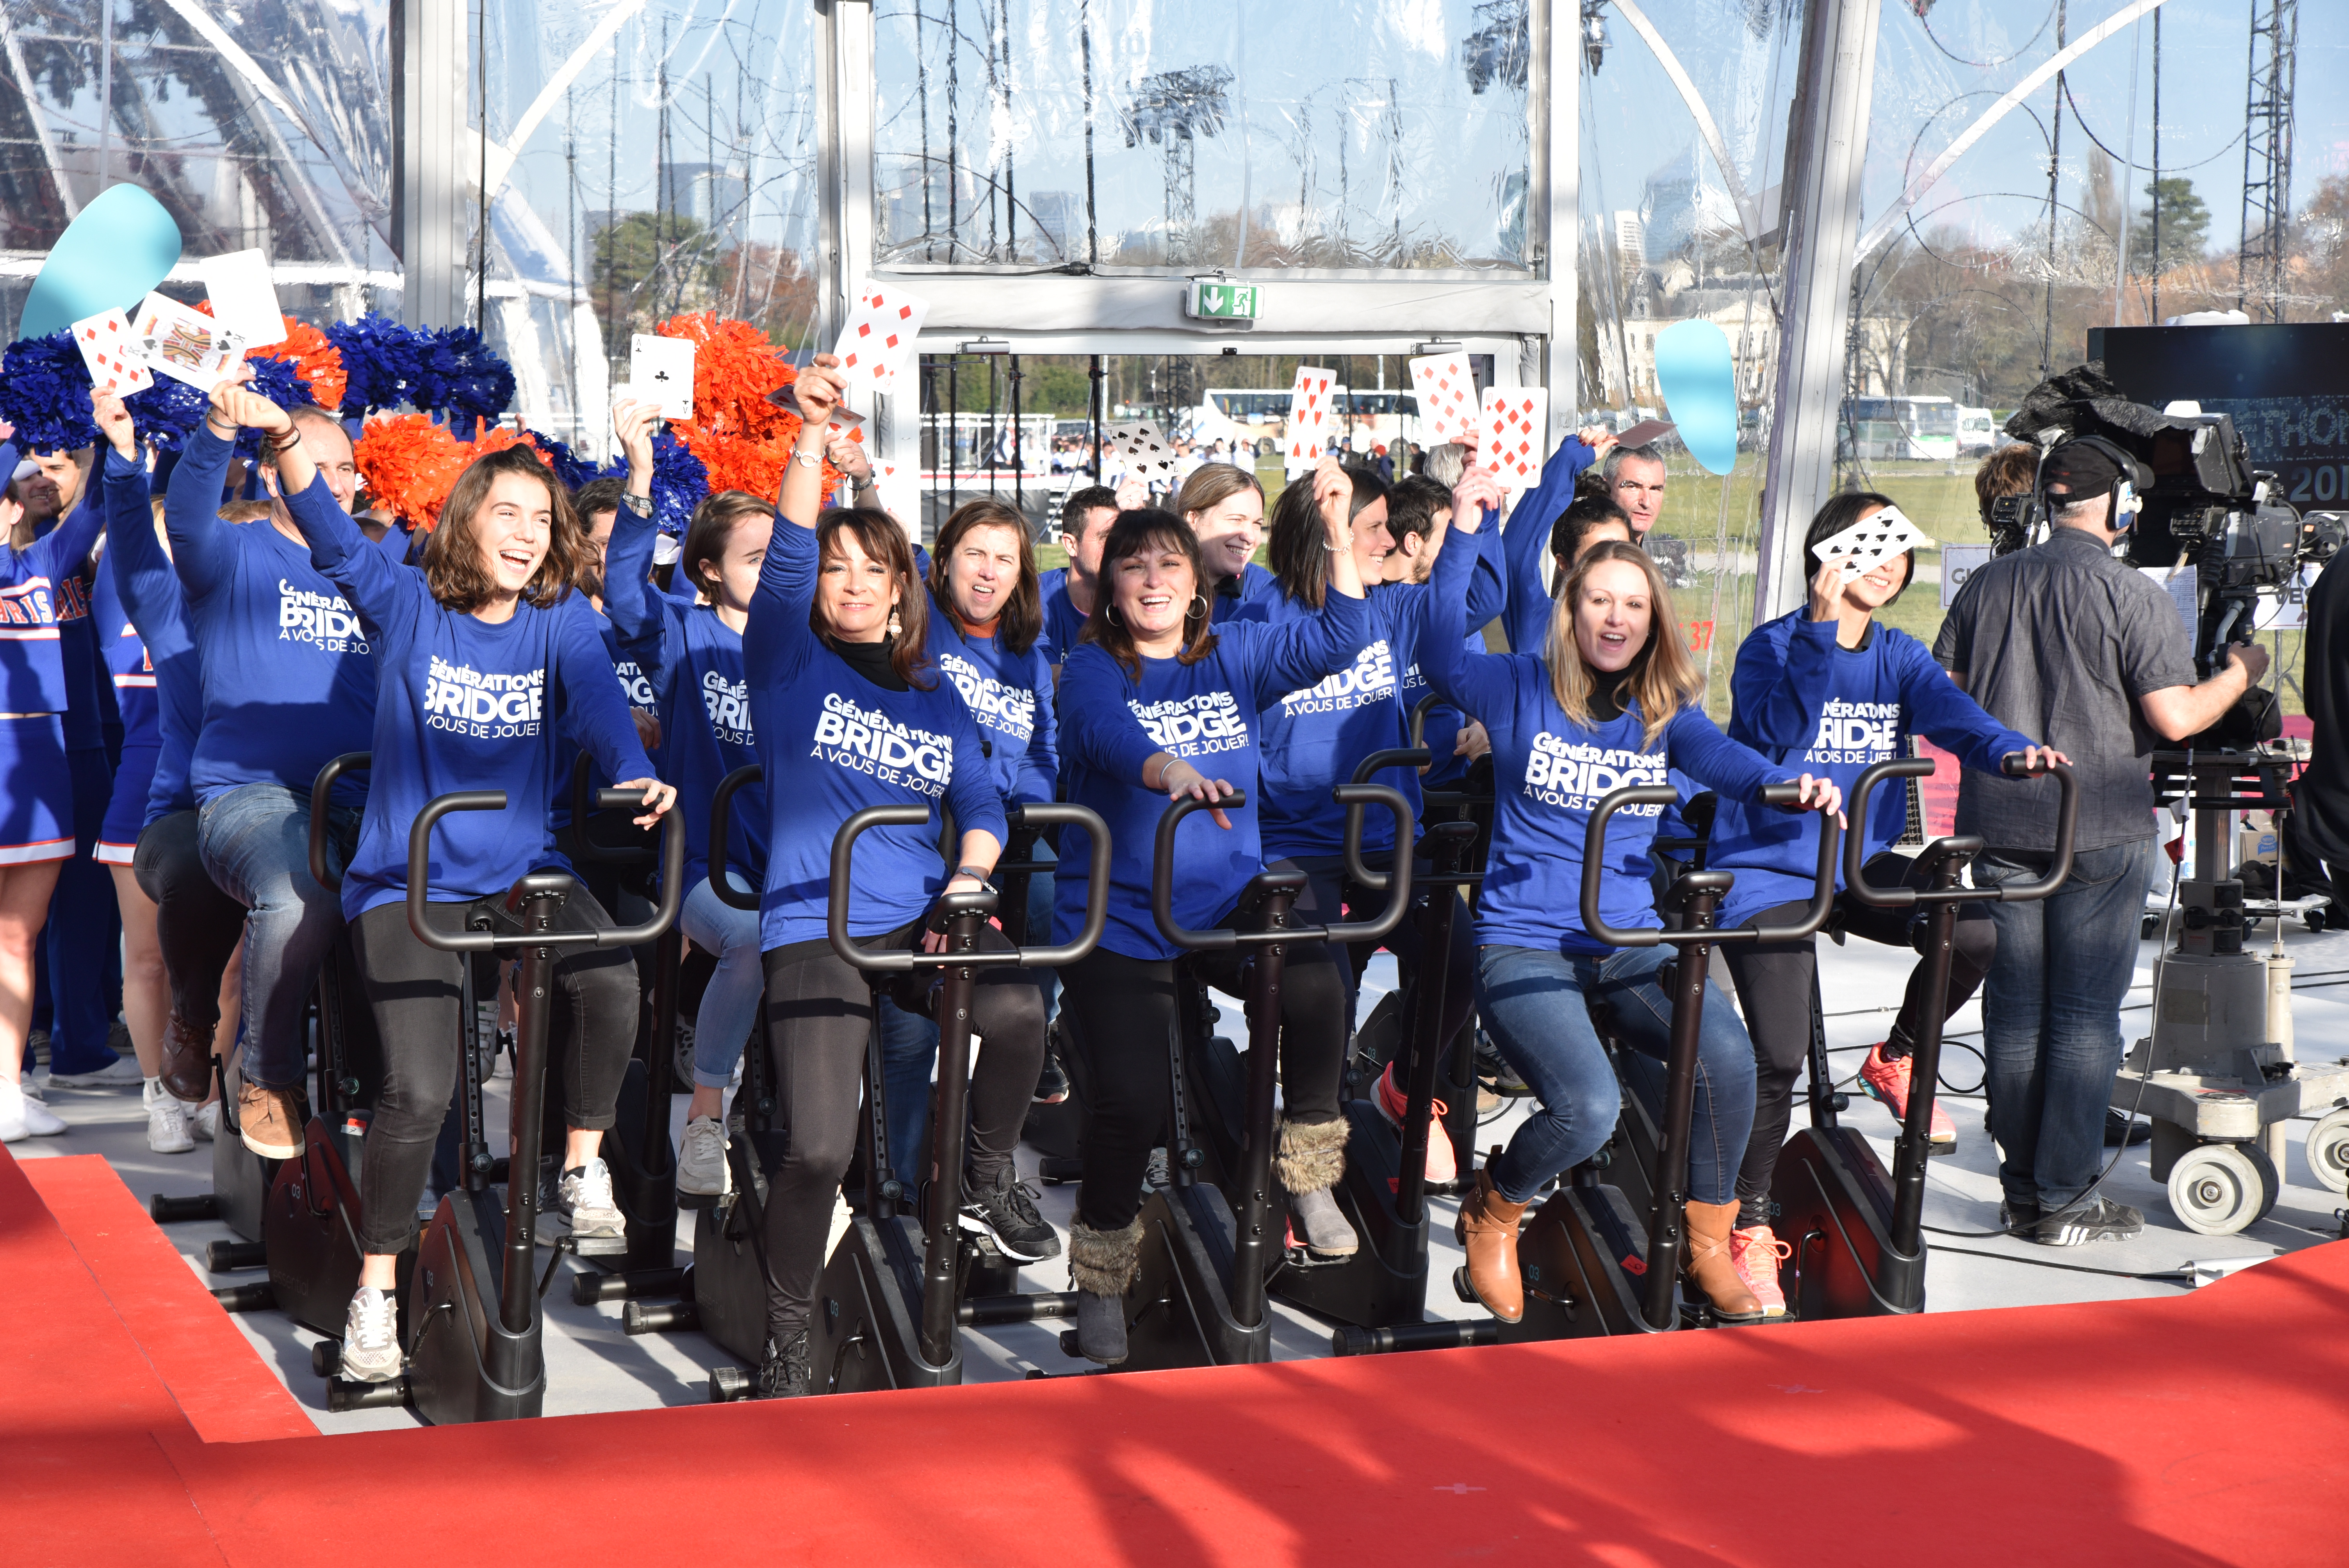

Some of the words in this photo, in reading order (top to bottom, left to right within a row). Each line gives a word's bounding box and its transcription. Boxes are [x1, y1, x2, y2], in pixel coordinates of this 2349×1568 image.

[866, 285, 873, 294] 6
[76, 326, 80, 335] 7
[233, 333, 245, 344] K
[128, 346, 140, 356] K
[1299, 371, 1303, 381] 7
[1486, 392, 1493, 403] 10
[0, 591, 53, 624] ARIS
[55, 577, 88, 622] RIS
[280, 596, 365, 641] BRID
[279, 626, 291, 641] À
[292, 629, 325, 651] VOS
[328, 639, 348, 652] DE
[1690, 621, 1714, 652] 37
[429, 655, 544, 691] GÉNÉRATIONS
[424, 677, 543, 723] BRIDGE
[703, 689, 752, 731] BRI
[1127, 691, 1234, 720] ÉNÉRATIONS
[1285, 702, 1296, 718] À
[1294, 699, 1334, 715] VOUS
[1336, 696, 1352, 710] DE
[470, 723, 489, 739] DE
[824, 693, 953, 754] GÉNÉRATIONS
[977, 711, 997, 728] DE
[1137, 703, 1247, 746] RIDGE
[1813, 717, 1898, 750] RIDE
[814, 710, 953, 785] BRIDGE
[1180, 742, 1199, 757] DE
[1533, 731, 1665, 768] GÉNÉRATIONS
[1845, 750, 1866, 764] DE
[810, 741, 823, 760] À
[827, 747, 875, 775] VOUS
[877, 765, 901, 784] DE
[1523, 782, 1533, 798] À
[1535, 787, 1583, 809] VOUS
[1585, 798, 1600, 811] D
[1614, 803, 1665, 817] OUER!
[1368, 1047, 1376, 1059] 03
[292, 1183, 301, 1199] 03
[1769, 1201, 1780, 1217] 03
[274, 1269, 308, 1297] essential
[427, 1270, 433, 1287] 03
[1136, 1267, 1141, 1281] 3
[831, 1299, 839, 1317] 03
